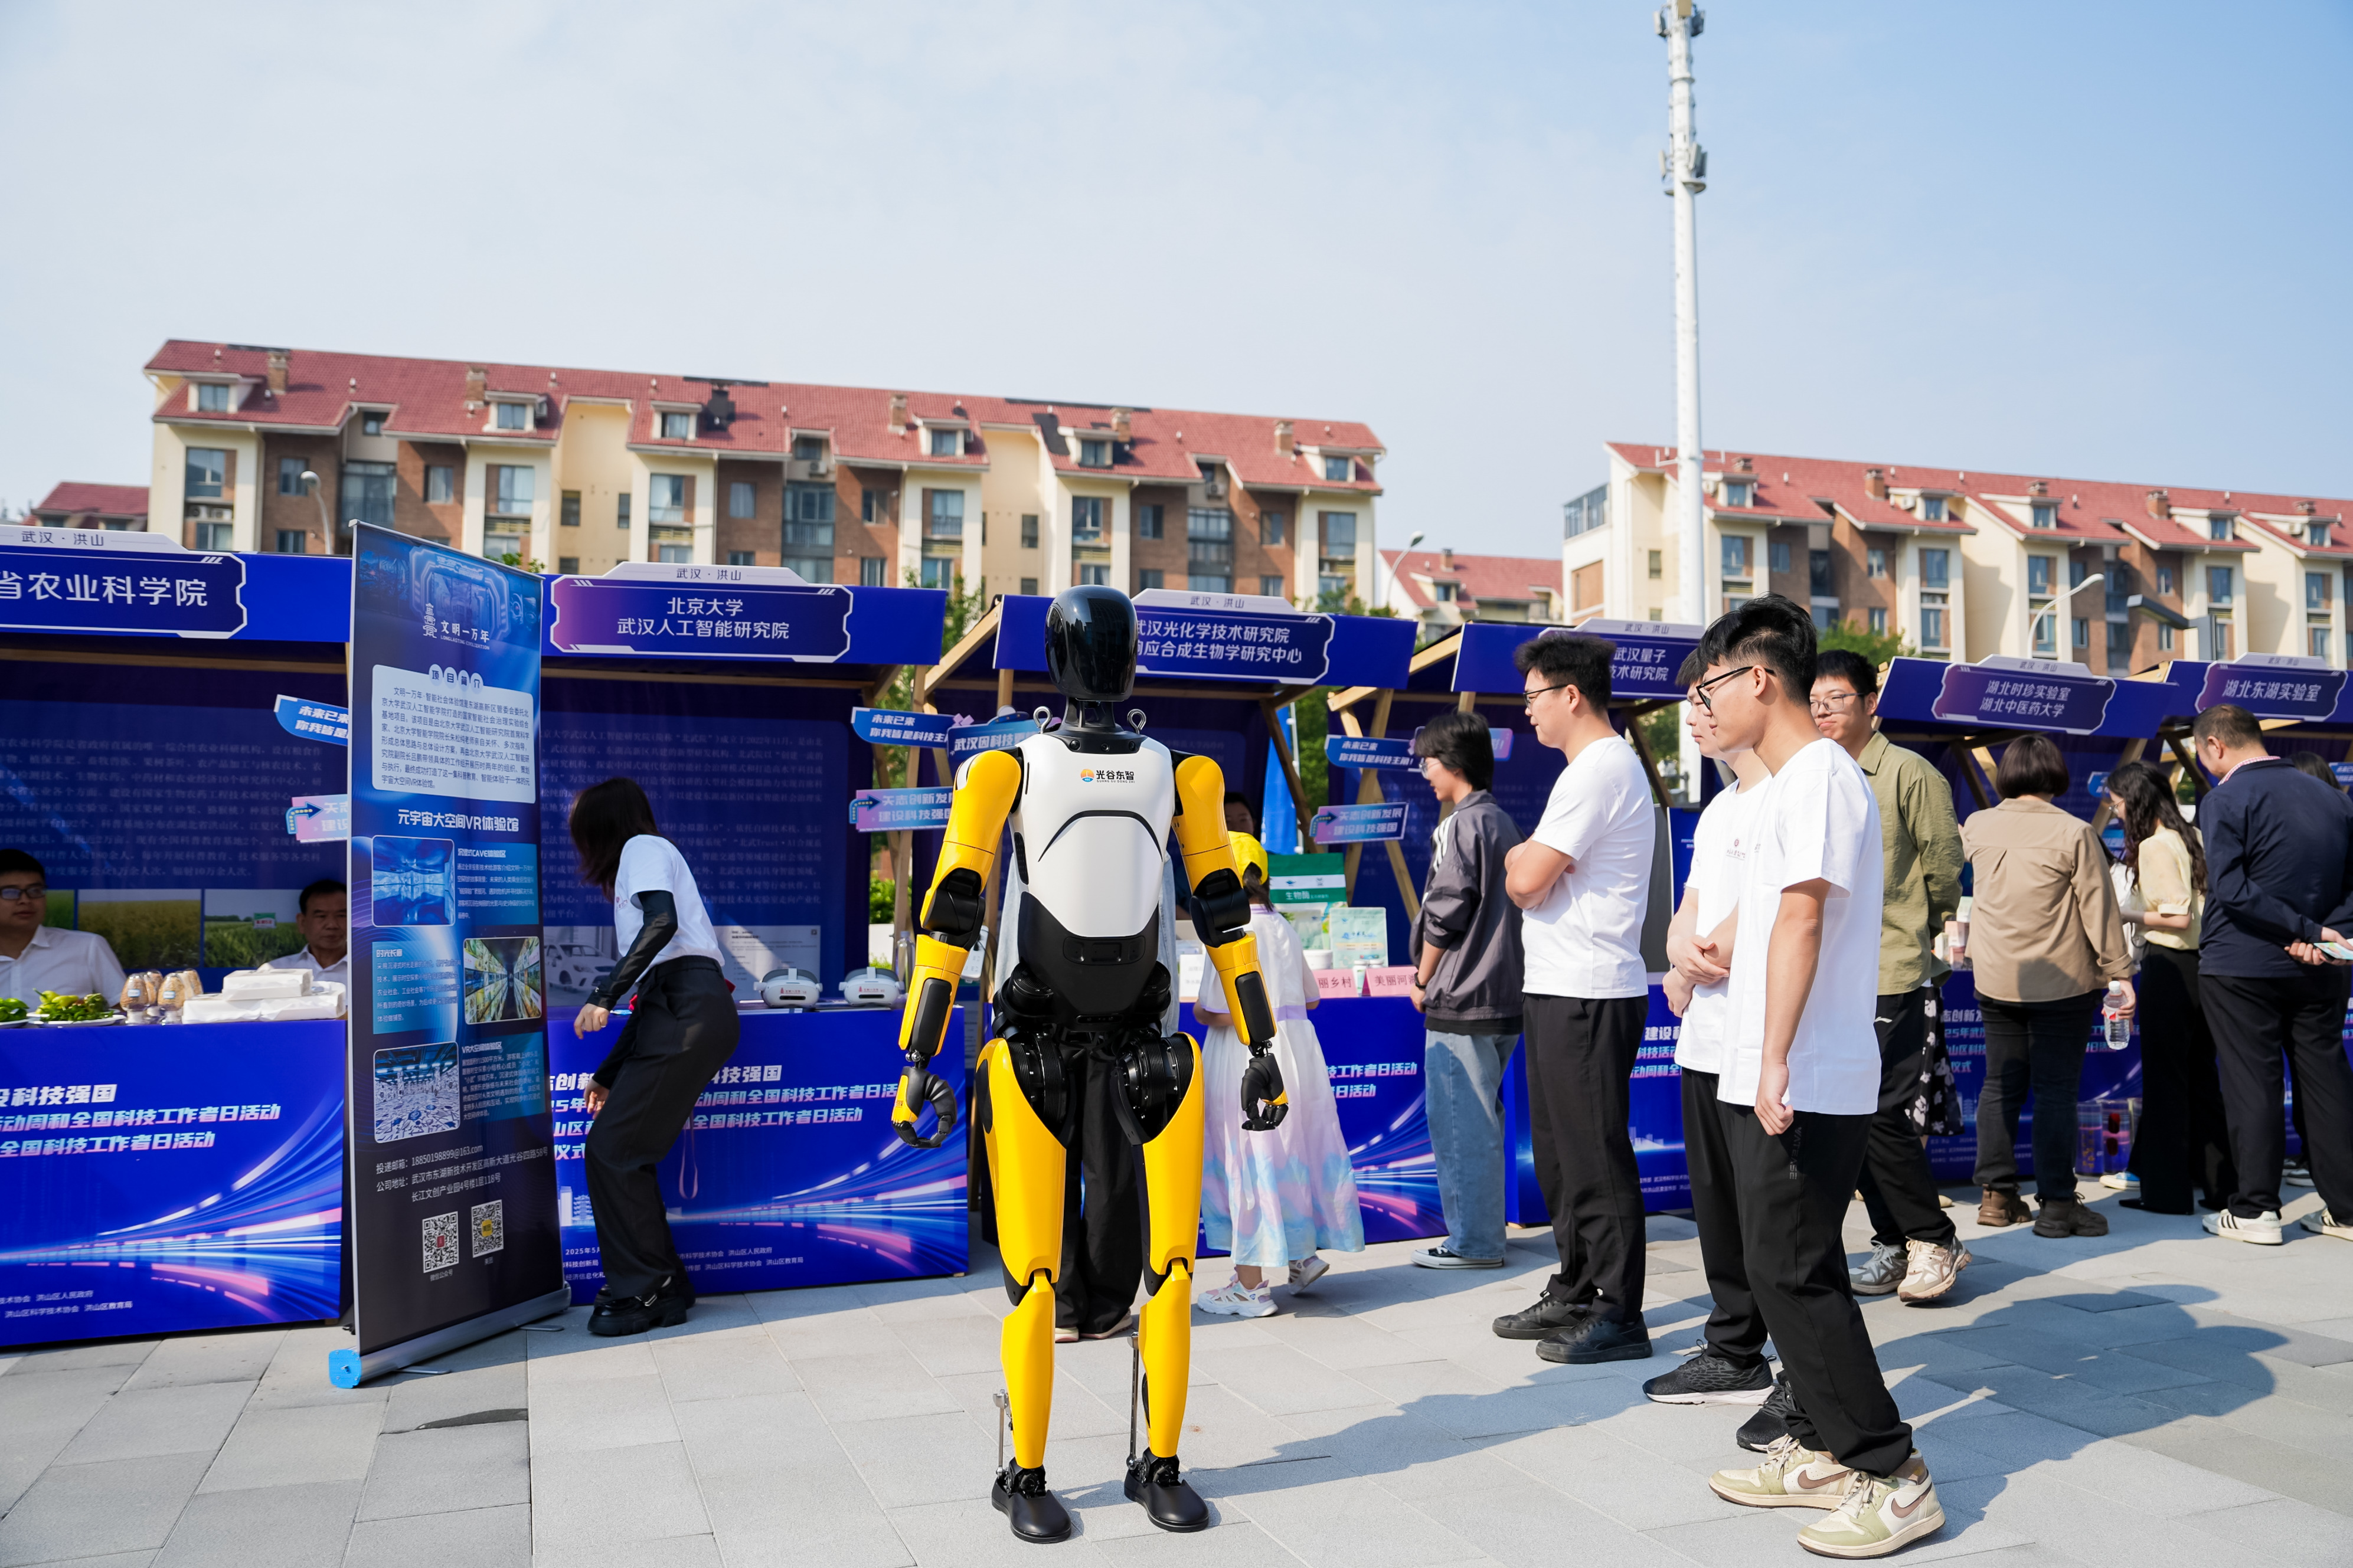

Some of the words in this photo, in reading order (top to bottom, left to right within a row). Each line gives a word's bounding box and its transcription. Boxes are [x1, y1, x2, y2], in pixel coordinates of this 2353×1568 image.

[675, 567, 743, 582] 武汉·洪山
[666, 597, 744, 617] 北京大学
[1189, 595, 1246, 609] 武汉·洪山
[440, 620, 490, 643] 文明一万年
[616, 617, 790, 640] 武汉人工智能研究院
[1613, 647, 1666, 664] 武汉量子
[432, 670, 481, 689] 项目简介
[1987, 679, 2071, 702] 湖北时珍实验室
[2221, 679, 2322, 703] 湖北东湖实验室
[1979, 698, 2065, 718] 湖北中医药大学
[295, 719, 349, 739] 你我皆是
[871, 714, 916, 727] 未来已来
[1096, 770, 1135, 780] 光谷东智
[398, 808, 519, 832] 元宇宙大空间VR体验馆
[551, 1098, 587, 1113] 5年
[683, 1107, 863, 1130] 全国科技工作者日活动
[554, 1143, 586, 1161] 仪式
[411, 1172, 502, 1203] 长江文创产业园4号楼1层118号
[728, 1246, 773, 1256] 洪山区人民政府
[705, 1258, 762, 1271] 洪山区科学技术协会
[766, 1256, 803, 1266] 洪山区教育局
